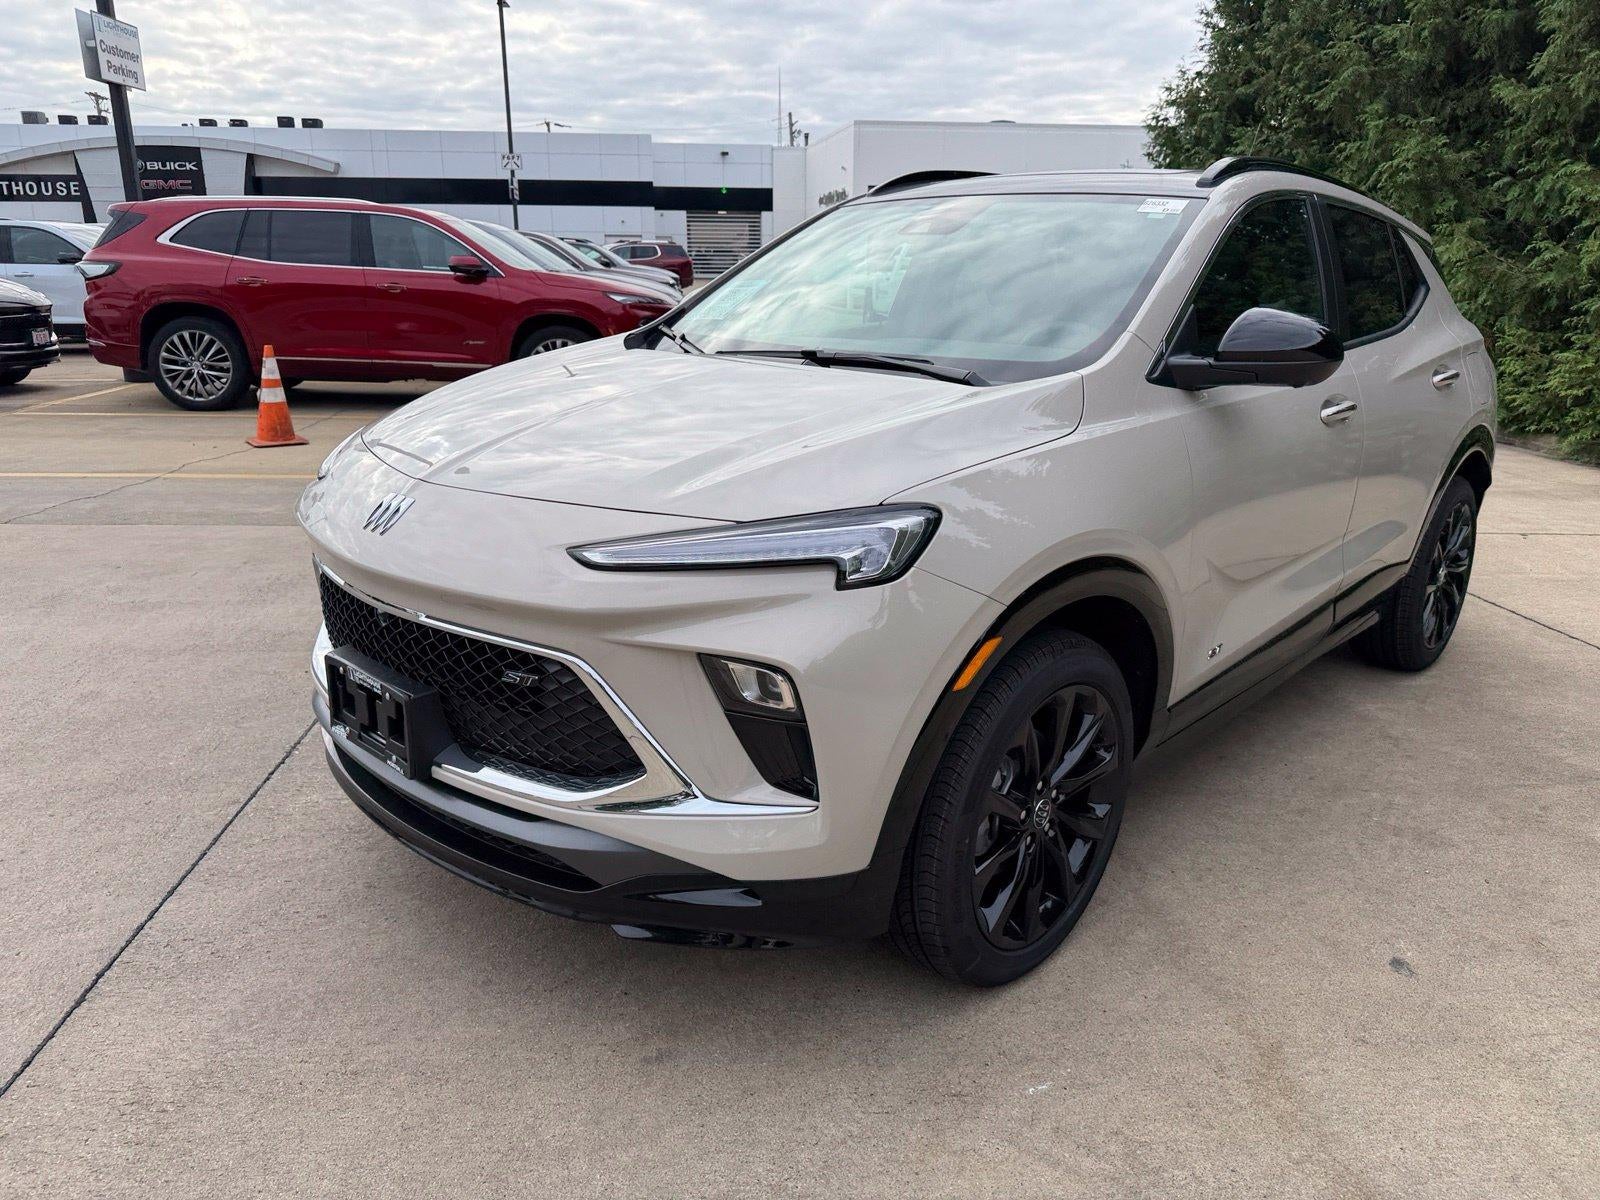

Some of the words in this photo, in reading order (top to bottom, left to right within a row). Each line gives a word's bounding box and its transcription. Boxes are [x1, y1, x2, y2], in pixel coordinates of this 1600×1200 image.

[103, 19, 138, 39] LIGHTHOUSE
[99, 39, 140, 63] Customer
[106, 59, 139, 83] Parking
[146, 161, 199, 171] BUICK
[0, 181, 81, 196] THOUSE
[140, 179, 192, 190] GMC
[501, 670, 539, 687] ST
